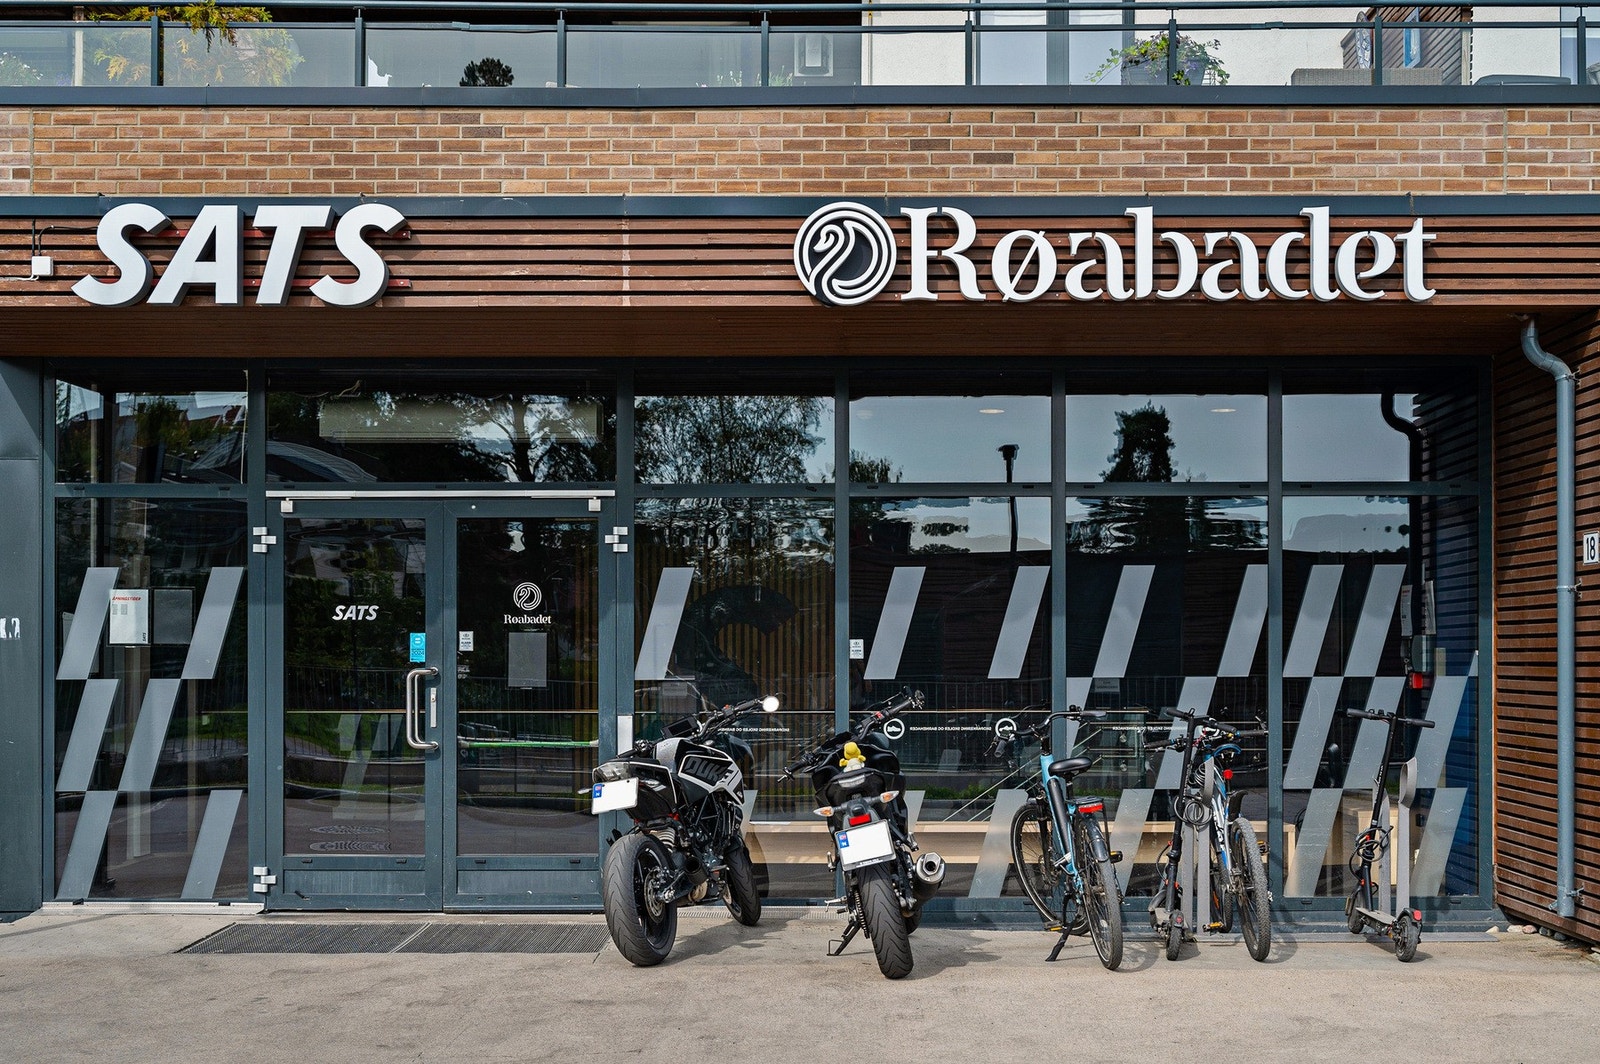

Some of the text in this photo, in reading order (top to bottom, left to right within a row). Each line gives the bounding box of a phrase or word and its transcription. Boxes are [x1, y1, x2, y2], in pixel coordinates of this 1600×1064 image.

[70, 203, 408, 306] SATS
[900, 205, 1438, 302] Røabadet
[1586, 536, 1596, 560] 18
[332, 605, 379, 620] SATS
[503, 614, 551, 624] Røabadet
